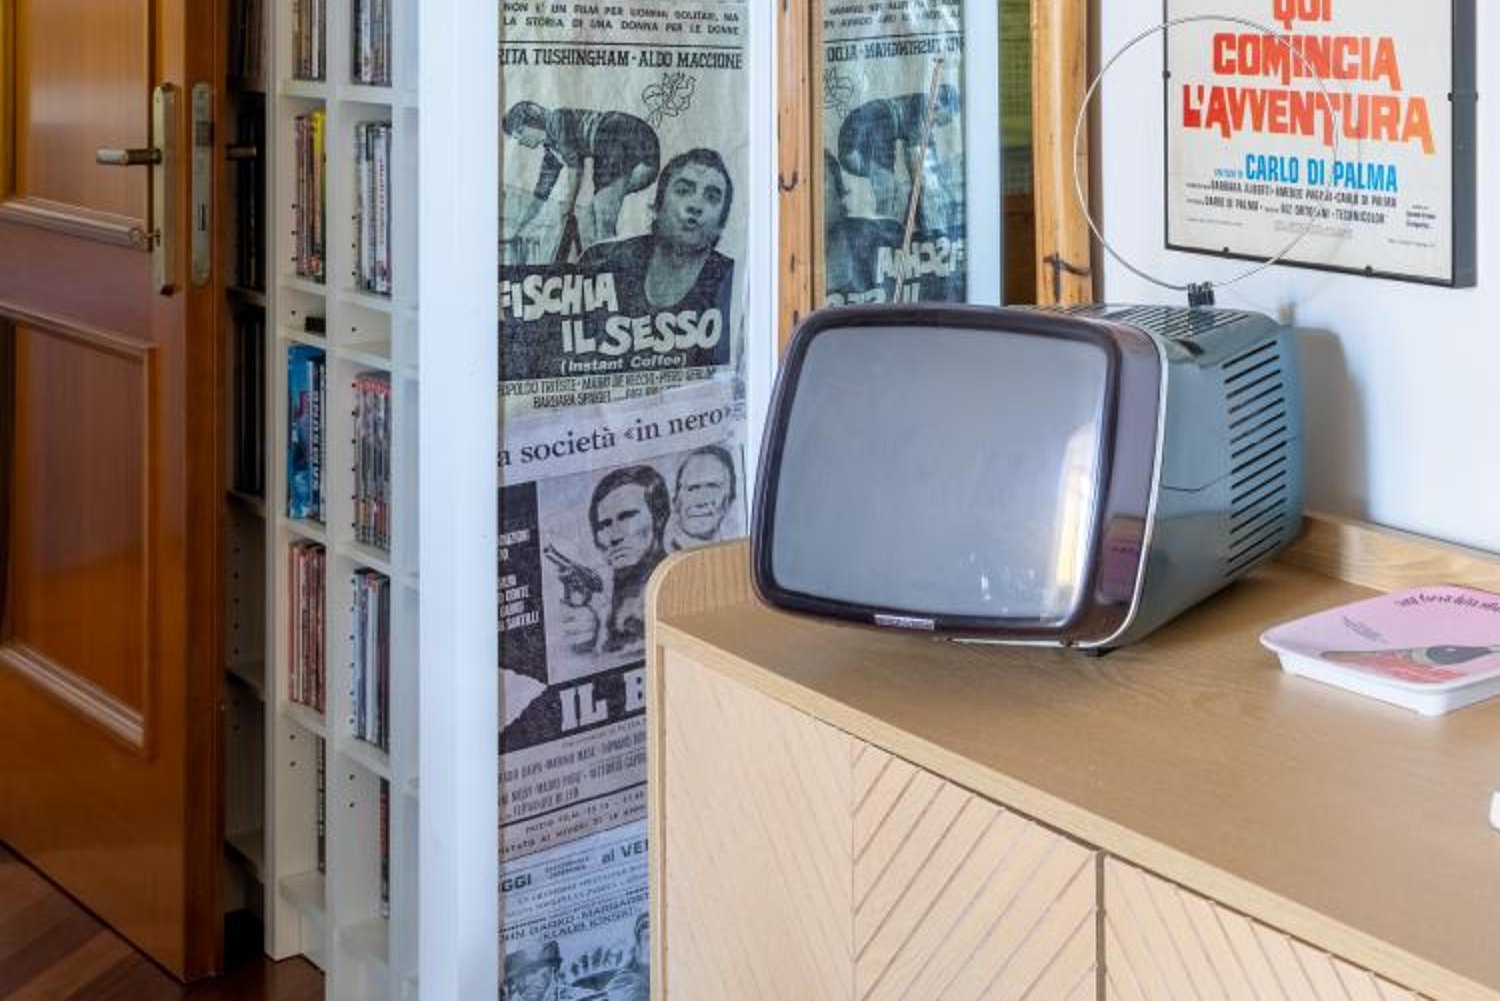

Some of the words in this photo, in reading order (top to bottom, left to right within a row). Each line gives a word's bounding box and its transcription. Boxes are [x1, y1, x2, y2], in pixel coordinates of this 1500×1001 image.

[503, 2, 529, 13] NON
[551, 4, 567, 14] UN
[574, 4, 600, 14] FILM
[605, 6, 624, 16] PER
[503, 16, 518, 26] LA
[525, 17, 565, 28] STORIA
[620, 20, 659, 31] DONNA
[665, 22, 683, 33] PER
[689, 24, 702, 34] LE
[707, 24, 740, 36] DONNE
[532, 47, 630, 67] TUSHINGHAM
[638, 50, 674, 68] ALDO
[676, 51, 743, 70] MACCIONE
[1212, 32, 1403, 91] COMINCIA
[1182, 84, 1436, 155] L'AVVENTURA
[1245, 153, 1299, 184] CARLO
[1307, 158, 1325, 186] DI
[1333, 160, 1398, 193] PALMA
[562, 318, 597, 353] IL
[601, 308, 723, 356] SESSO
[561, 359, 624, 376] (Instant
[630, 353, 688, 370] Coffee)
[520, 426, 616, 465] società
[560, 683, 608, 732] IL
[499, 873, 532, 893] GGI
[621, 838, 649, 859] VE
